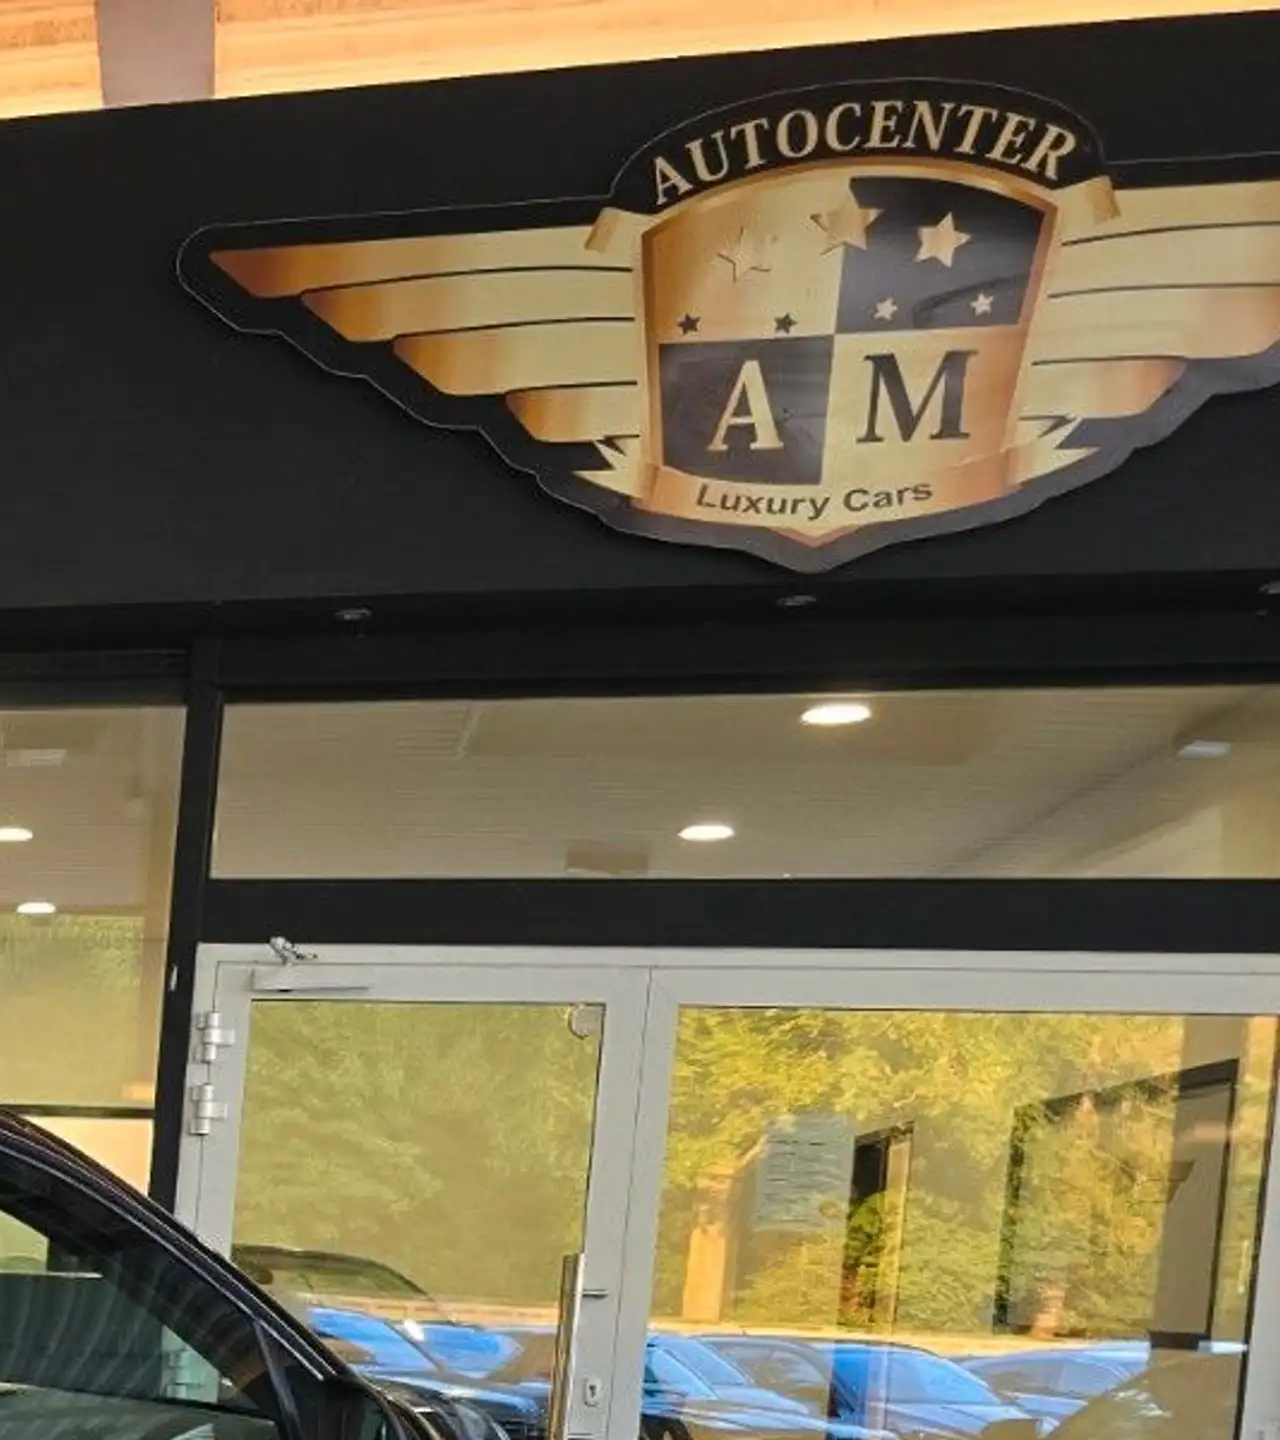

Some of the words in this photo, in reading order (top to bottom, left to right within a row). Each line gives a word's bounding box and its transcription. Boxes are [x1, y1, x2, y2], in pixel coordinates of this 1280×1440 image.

[653, 99, 1077, 206] AUTOCENTER
[706, 359, 785, 451] A
[855, 349, 980, 443] M
[695, 483, 831, 521] Luxury
[841, 480, 934, 513] Cars
